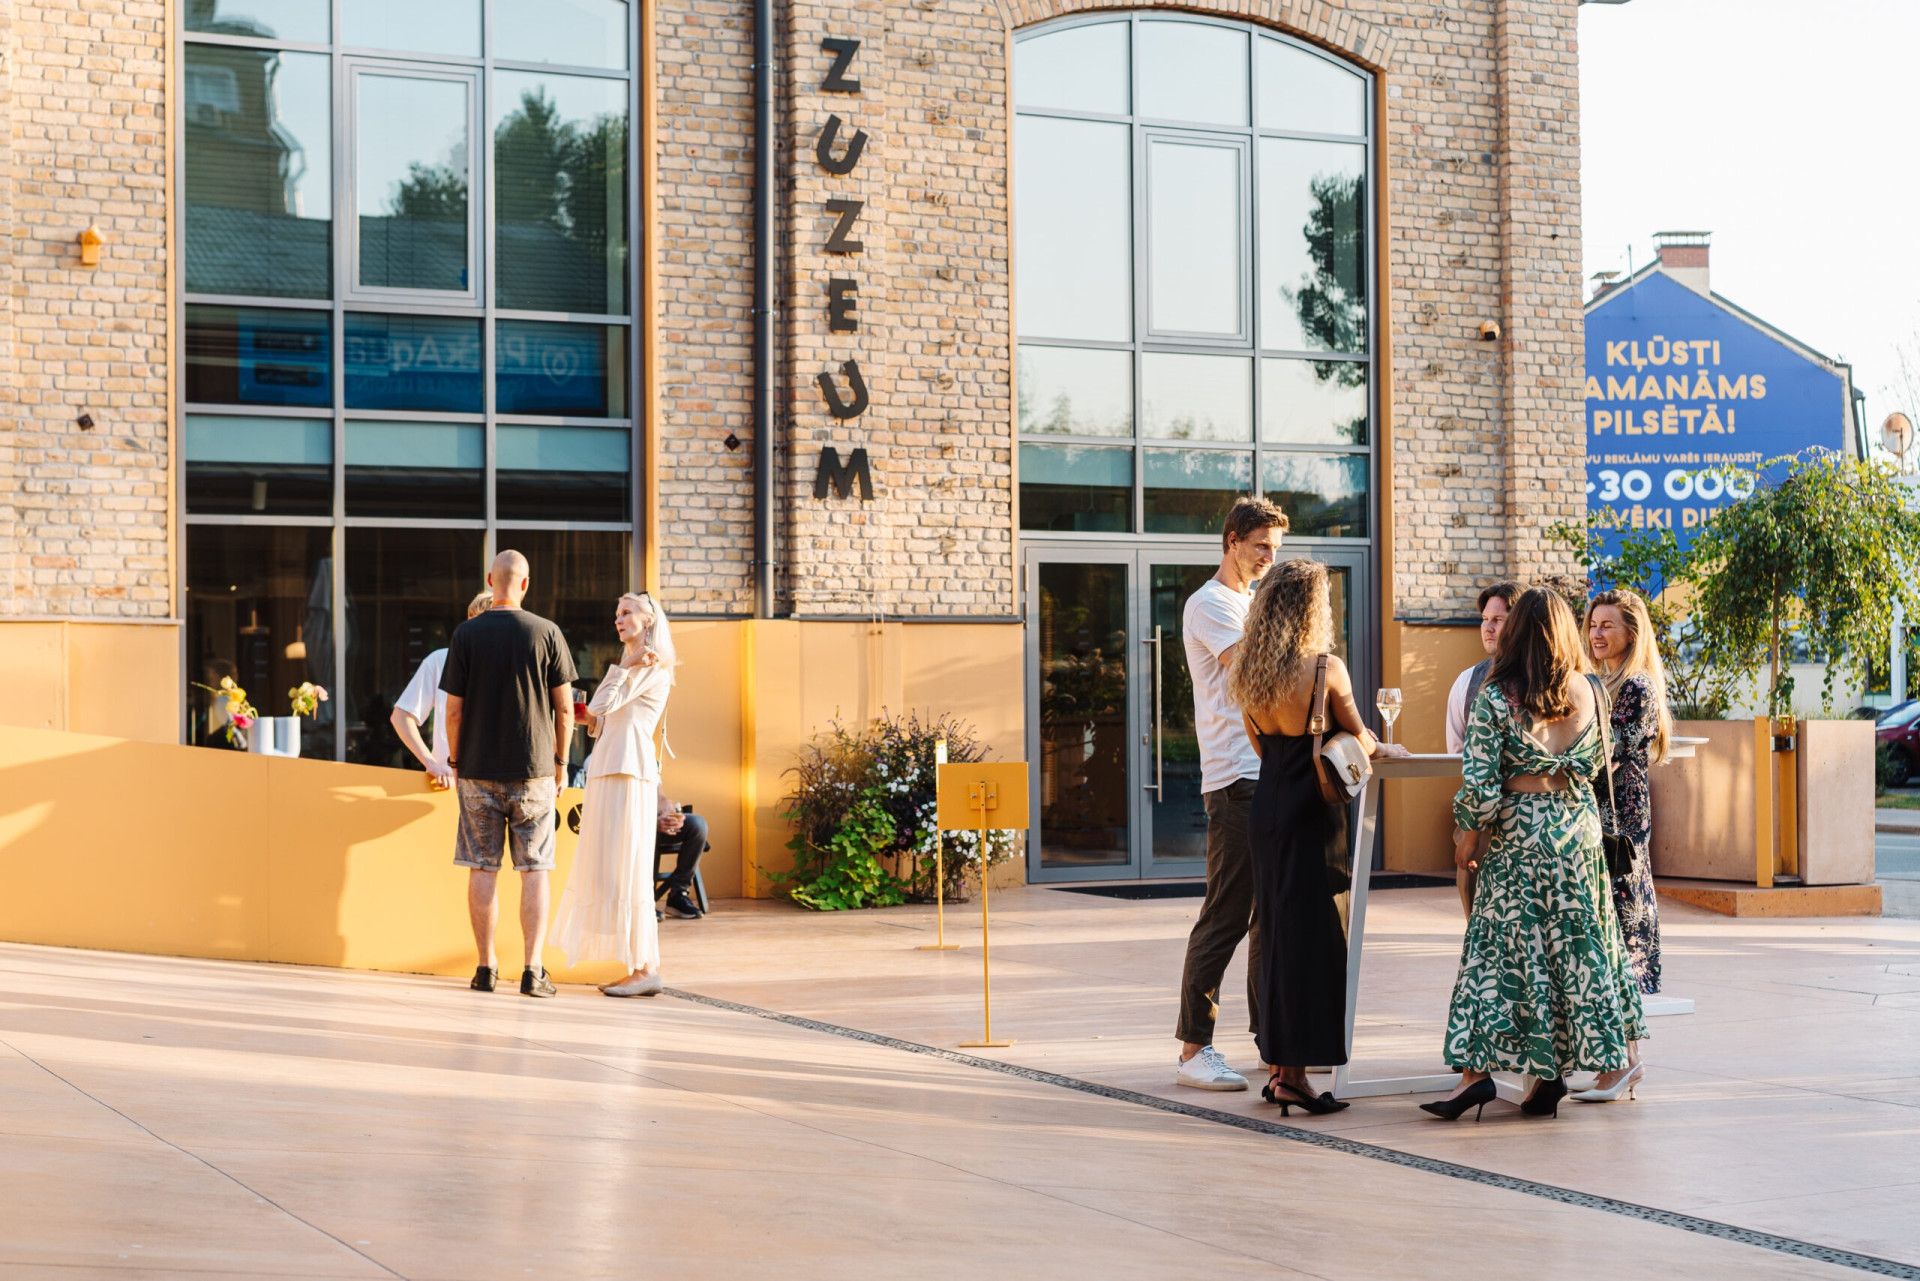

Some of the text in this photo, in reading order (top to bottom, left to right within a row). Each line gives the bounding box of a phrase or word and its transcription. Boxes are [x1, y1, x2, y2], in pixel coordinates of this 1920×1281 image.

[814, 37, 874, 501] ZUZEUM
[1606, 335, 1720, 373] KĻŪSTI
[1584, 369, 1767, 400] AMANĀMS
[1593, 403, 1736, 435] PILSĒTĀ!
[1585, 450, 1763, 464] VU REKLĀMU VARĒS IERAUDZĪT
[1664, 468, 1755, 501] 000
